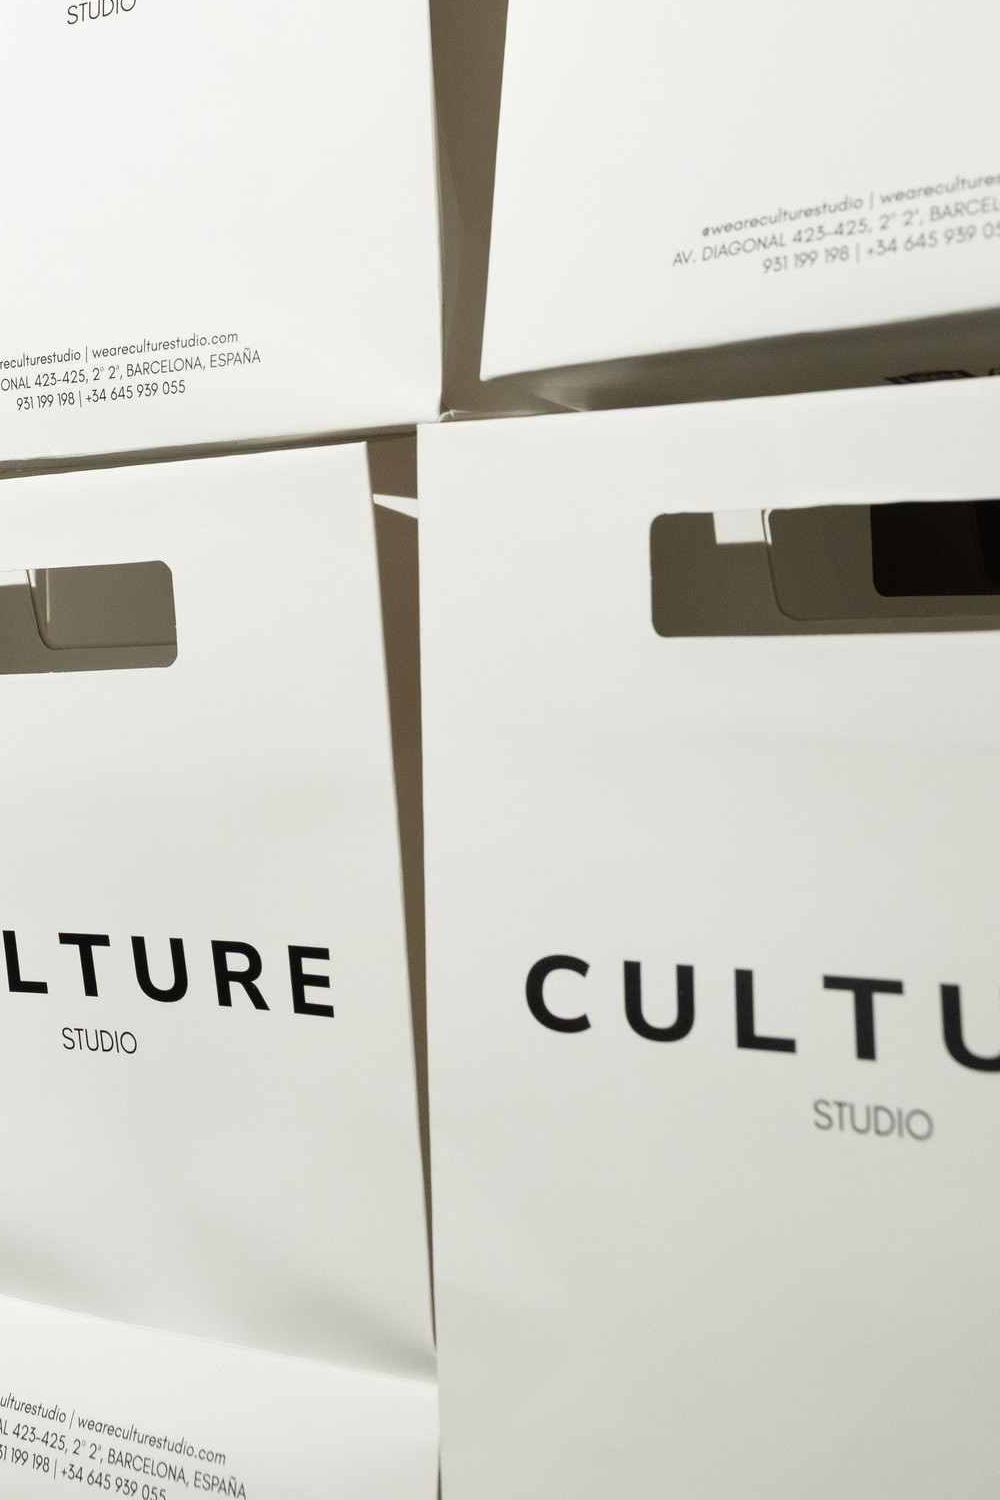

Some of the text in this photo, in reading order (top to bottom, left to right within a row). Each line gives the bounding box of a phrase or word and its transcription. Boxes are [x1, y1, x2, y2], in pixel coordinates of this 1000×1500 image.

[671, 250, 696, 266] AV.
[701, 233, 786, 261] DIAGONAL
[762, 255, 788, 274] 931
[794, 250, 819, 269] 199
[824, 244, 850, 264] 198
[867, 237, 897, 256] +34
[904, 230, 938, 251] 645
[943, 224, 977, 245] 939
[34, 368, 89, 387] 423-425,
[126, 356, 206, 378] BARCELONA,
[209, 347, 262, 369] ESPAÑA
[91, 332, 239, 359] weareculturestudio.com
[16, 396, 34, 411] 931
[37, 394, 54, 408] 199
[57, 391, 75, 406] 198
[85, 388, 107, 404] +34
[110, 385, 133, 400] 645
[136, 382, 159, 398] 939
[162, 379, 186, 395] 055
[525, 954, 1000, 1075] CULTU
[62, 1027, 138, 1054] STUDIO
[813, 1099, 934, 1142] STUDIO
[12, 1422, 68, 1455] 423-425,
[107, 1447, 189, 1487] BARCELONA,
[194, 1470, 247, 1500] ESPAÑA
[77, 1416, 226, 1465] weareculturestudio.com
[11, 1447, 28, 1466] 199
[32, 1453, 50, 1473] 198
[61, 1463, 83, 1482] +34
[86, 1469, 111, 1490] 645
[115, 1477, 138, 1497] 939
[141, 1484, 167, 1500] 055
